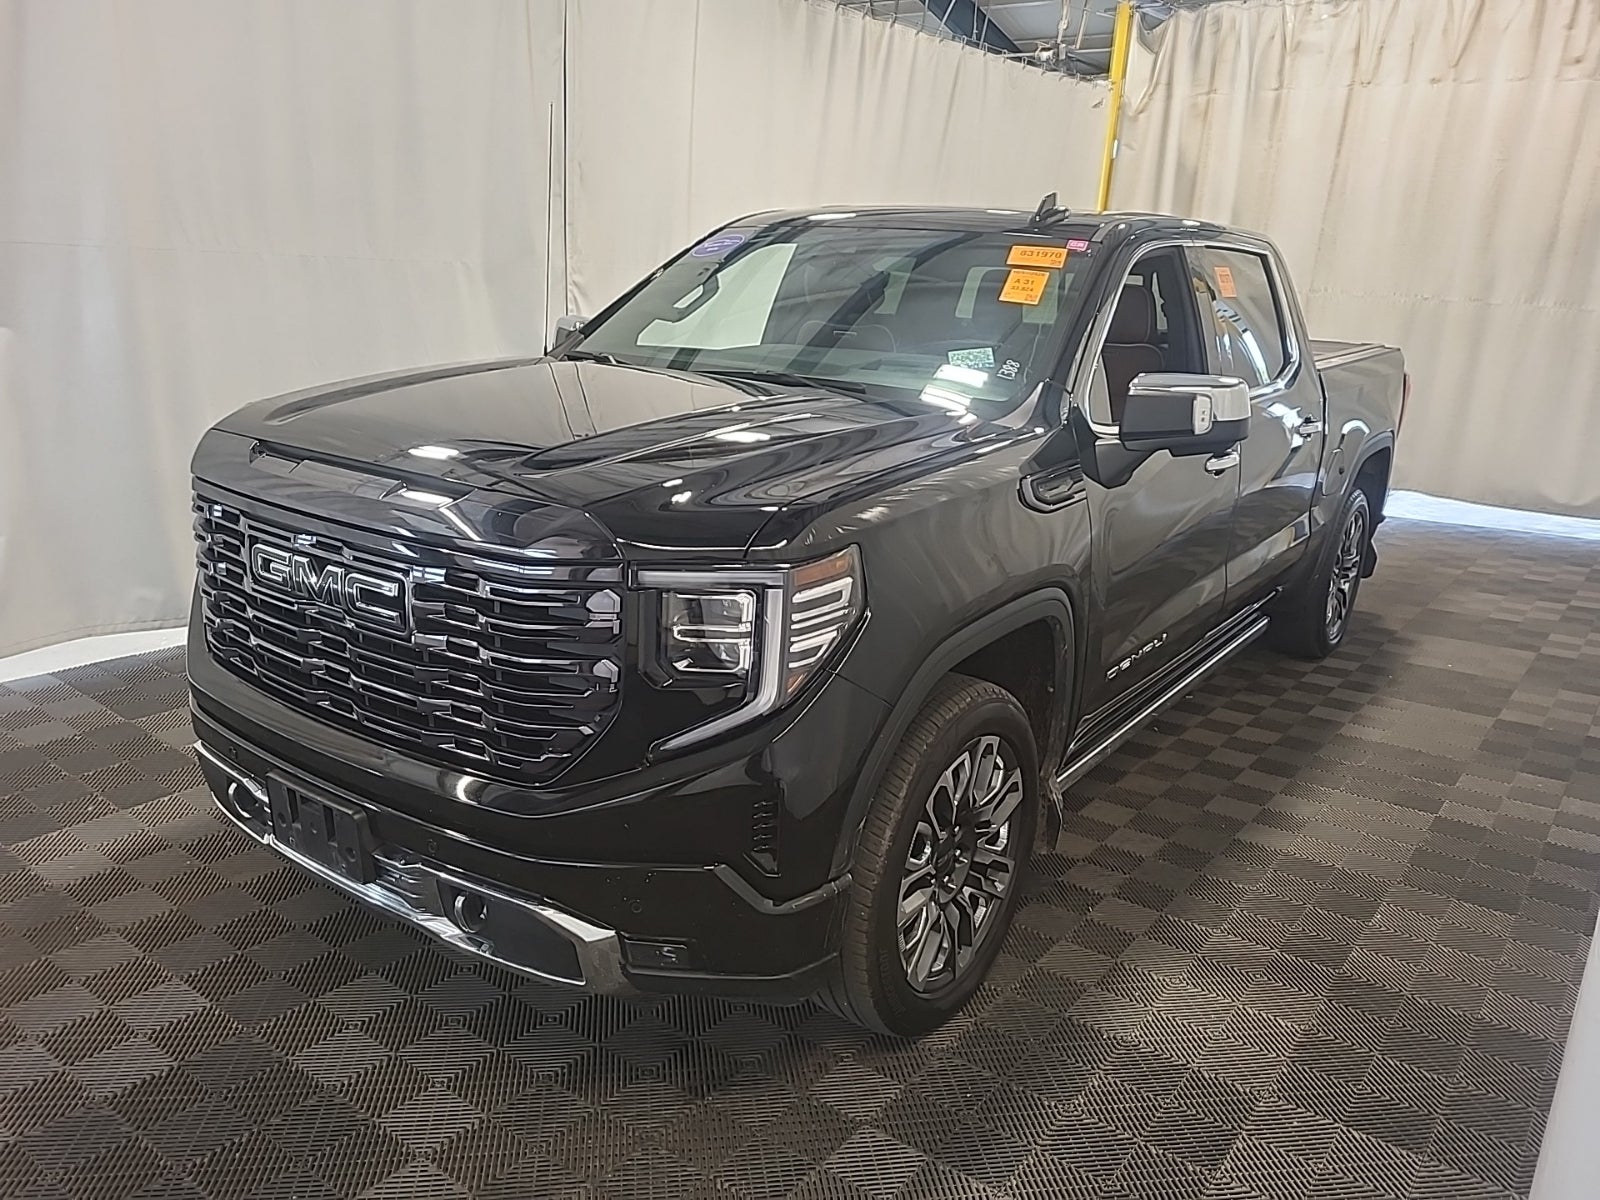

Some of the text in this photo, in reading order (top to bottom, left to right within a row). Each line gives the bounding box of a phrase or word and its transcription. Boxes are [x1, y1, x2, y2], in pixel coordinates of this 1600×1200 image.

[996, 359, 1020, 380] 1388
[251, 543, 402, 625] GMC
[1105, 633, 1167, 682] DENALI
